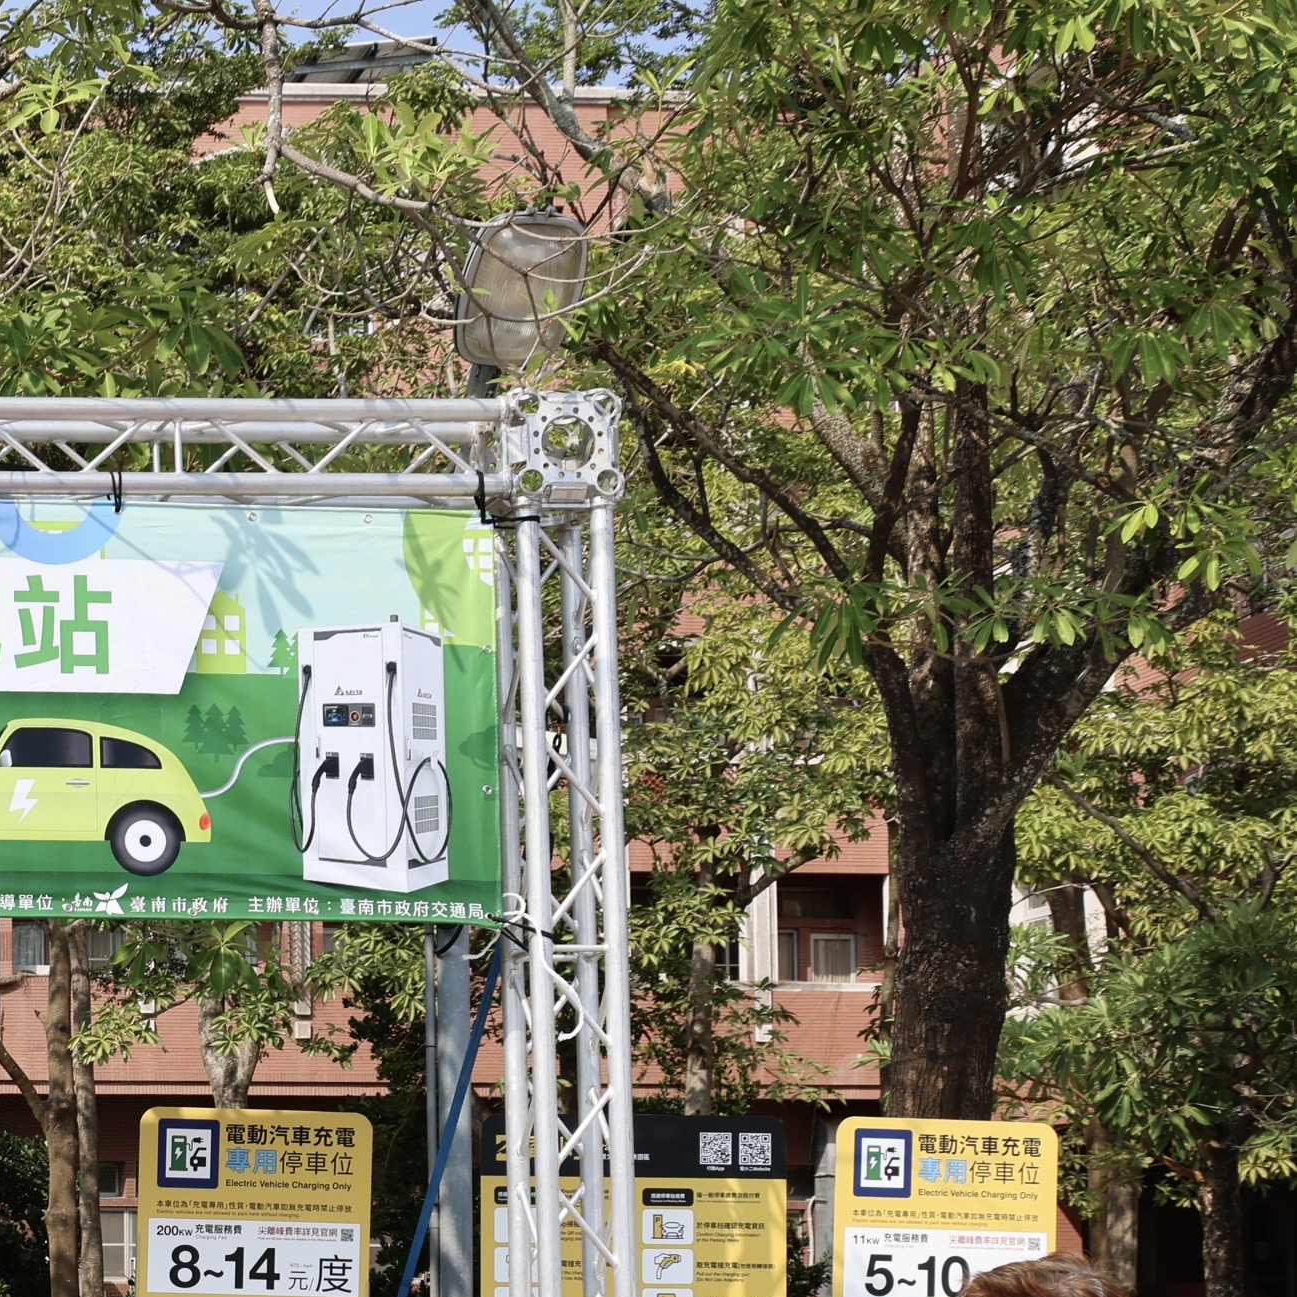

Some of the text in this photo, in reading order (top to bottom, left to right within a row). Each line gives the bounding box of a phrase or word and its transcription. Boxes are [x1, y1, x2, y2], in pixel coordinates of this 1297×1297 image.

[130, 896, 230, 914] 臺南市政府
[225, 1124, 355, 1147] 電動汽車充電
[918, 1134, 1041, 1157] 電動汽車充電
[225, 1147, 353, 1175] 專用停車位
[918, 1157, 1040, 1185] 專用停車位
[226, 1179, 352, 1191] Electric Vehicle Charging Only
[950, 1190, 979, 1198] Vehicle
[981, 1190, 1017, 1200] Charging
[1020, 1192, 1038, 1201] Only
[156, 1225, 193, 1236] 200KW
[195, 1224, 242, 1235] 充電服務費
[853, 1234, 880, 1245] 11KW
[883, 1233, 928, 1243] 充電服務費
[169, 1244, 353, 1293] 8~14 元/度
